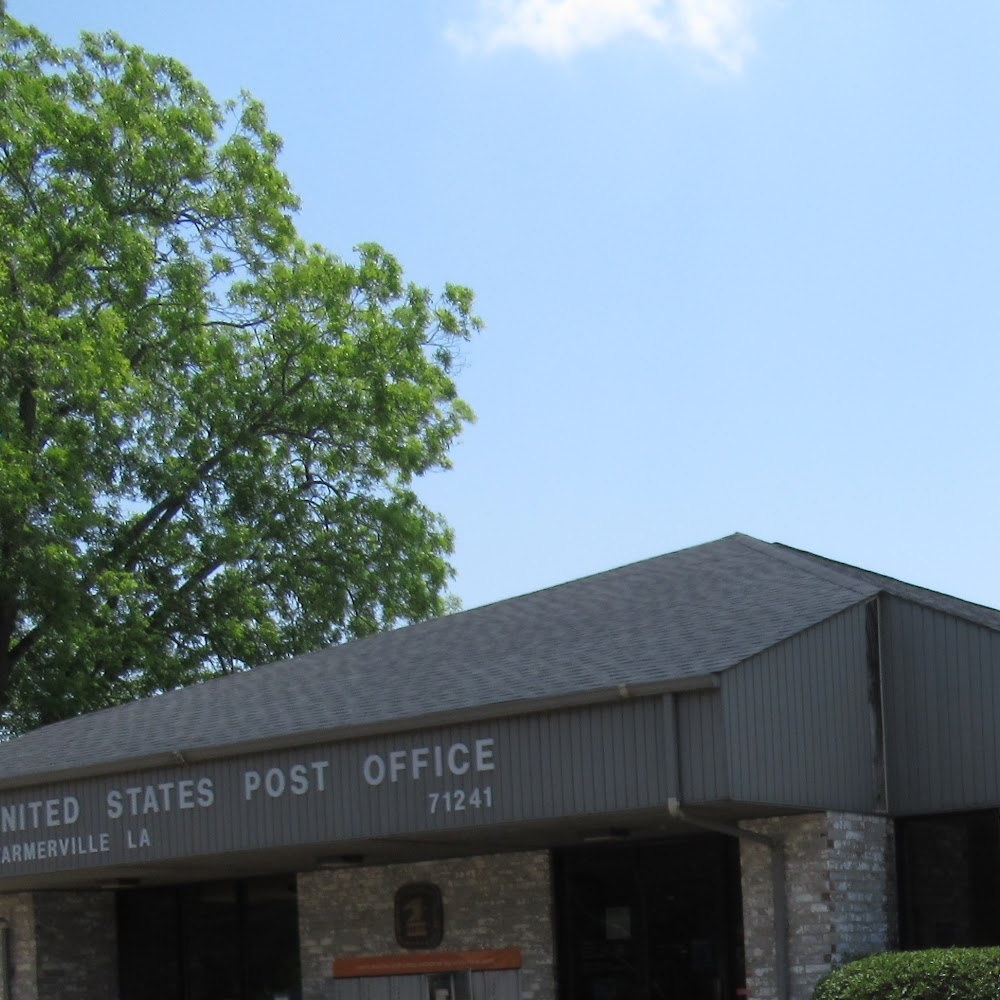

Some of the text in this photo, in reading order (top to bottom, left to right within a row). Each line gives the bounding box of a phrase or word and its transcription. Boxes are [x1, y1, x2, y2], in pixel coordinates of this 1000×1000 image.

[1, 738, 496, 833] NITED STATES POST OFFICE
[428, 786, 493, 814] 71241
[0, 828, 151, 864] ARMERVILLE LA
